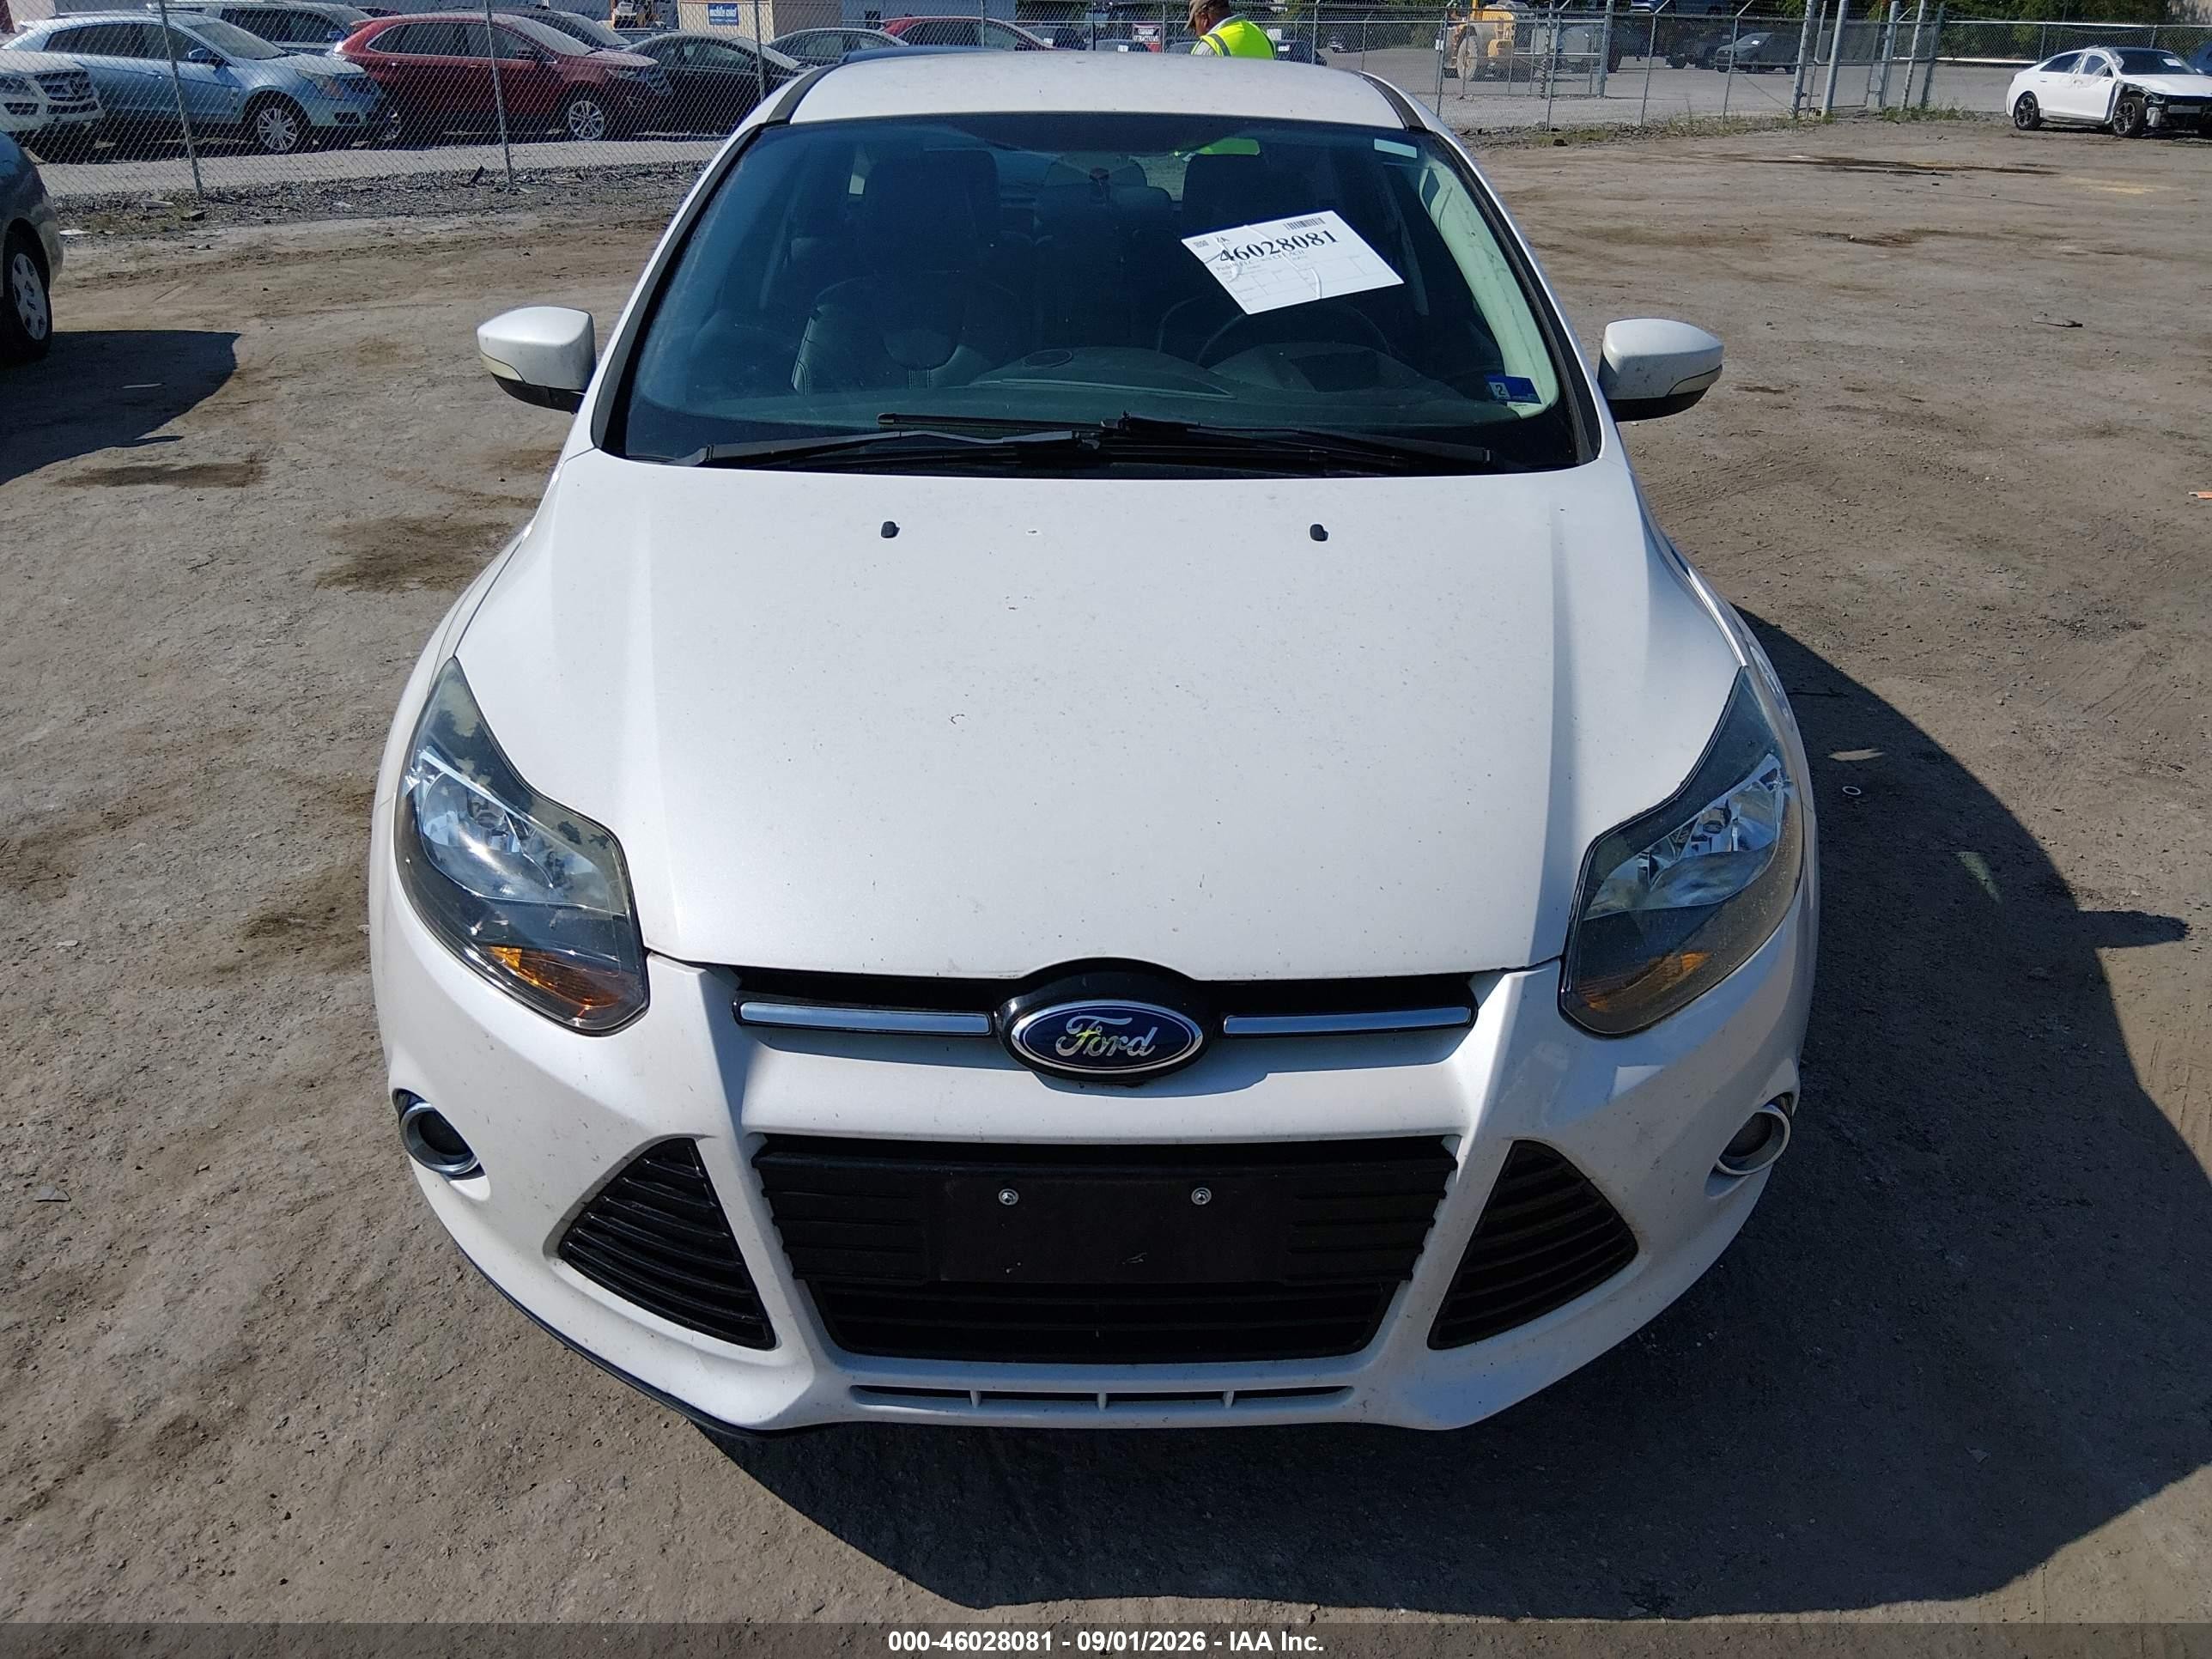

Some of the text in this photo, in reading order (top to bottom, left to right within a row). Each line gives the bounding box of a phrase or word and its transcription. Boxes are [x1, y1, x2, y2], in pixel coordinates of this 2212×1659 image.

[1219, 230, 1340, 262] 46028081
[1495, 384, 1506, 396] 2
[1055, 1015, 1158, 1056] Ford
